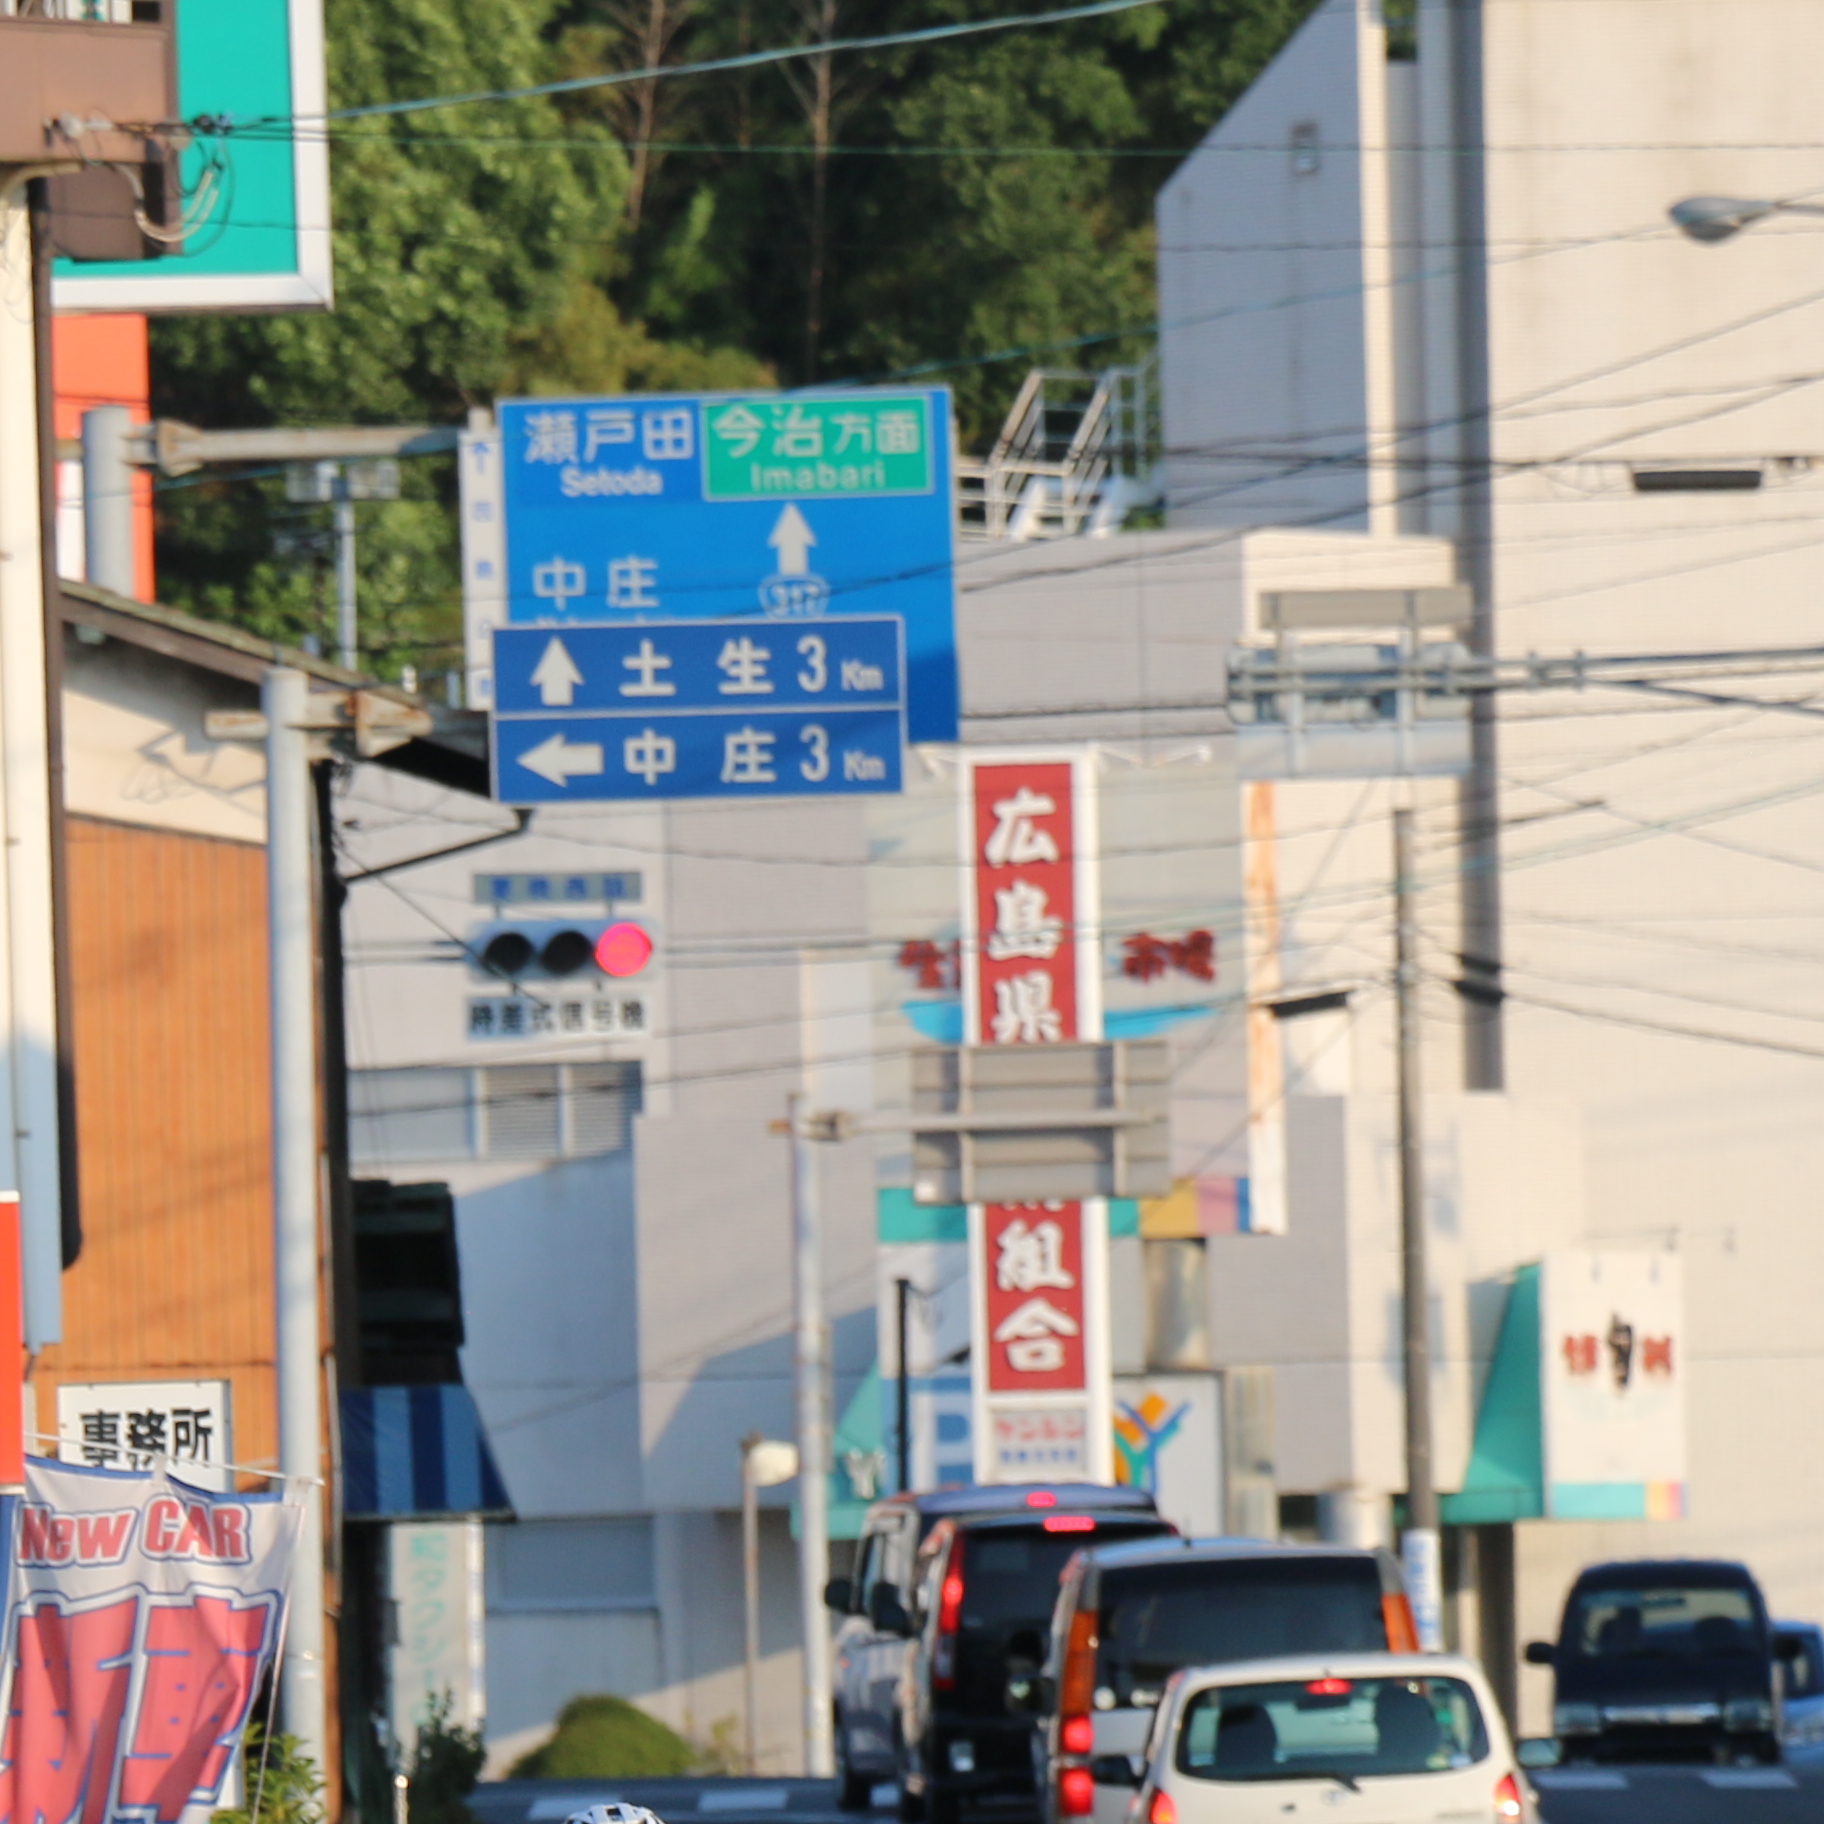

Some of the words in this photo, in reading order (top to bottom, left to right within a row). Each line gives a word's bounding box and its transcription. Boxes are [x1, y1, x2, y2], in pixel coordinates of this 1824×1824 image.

[524, 409, 694, 464] 瀬戸田
[712, 405, 923, 458] 今治方面
[560, 466, 663, 498] Setoda
[751, 461, 886, 491] Imabari
[533, 555, 659, 610] 中庄
[796, 635, 828, 692] 3
[800, 725, 830, 782] 3
[984, 785, 1064, 1042] 広島県
[994, 1200, 1079, 1372] 組合
[80, 1407, 213, 1468] 事務所
[18, 1500, 135, 1565] New
[143, 1497, 249, 1563] CAR
